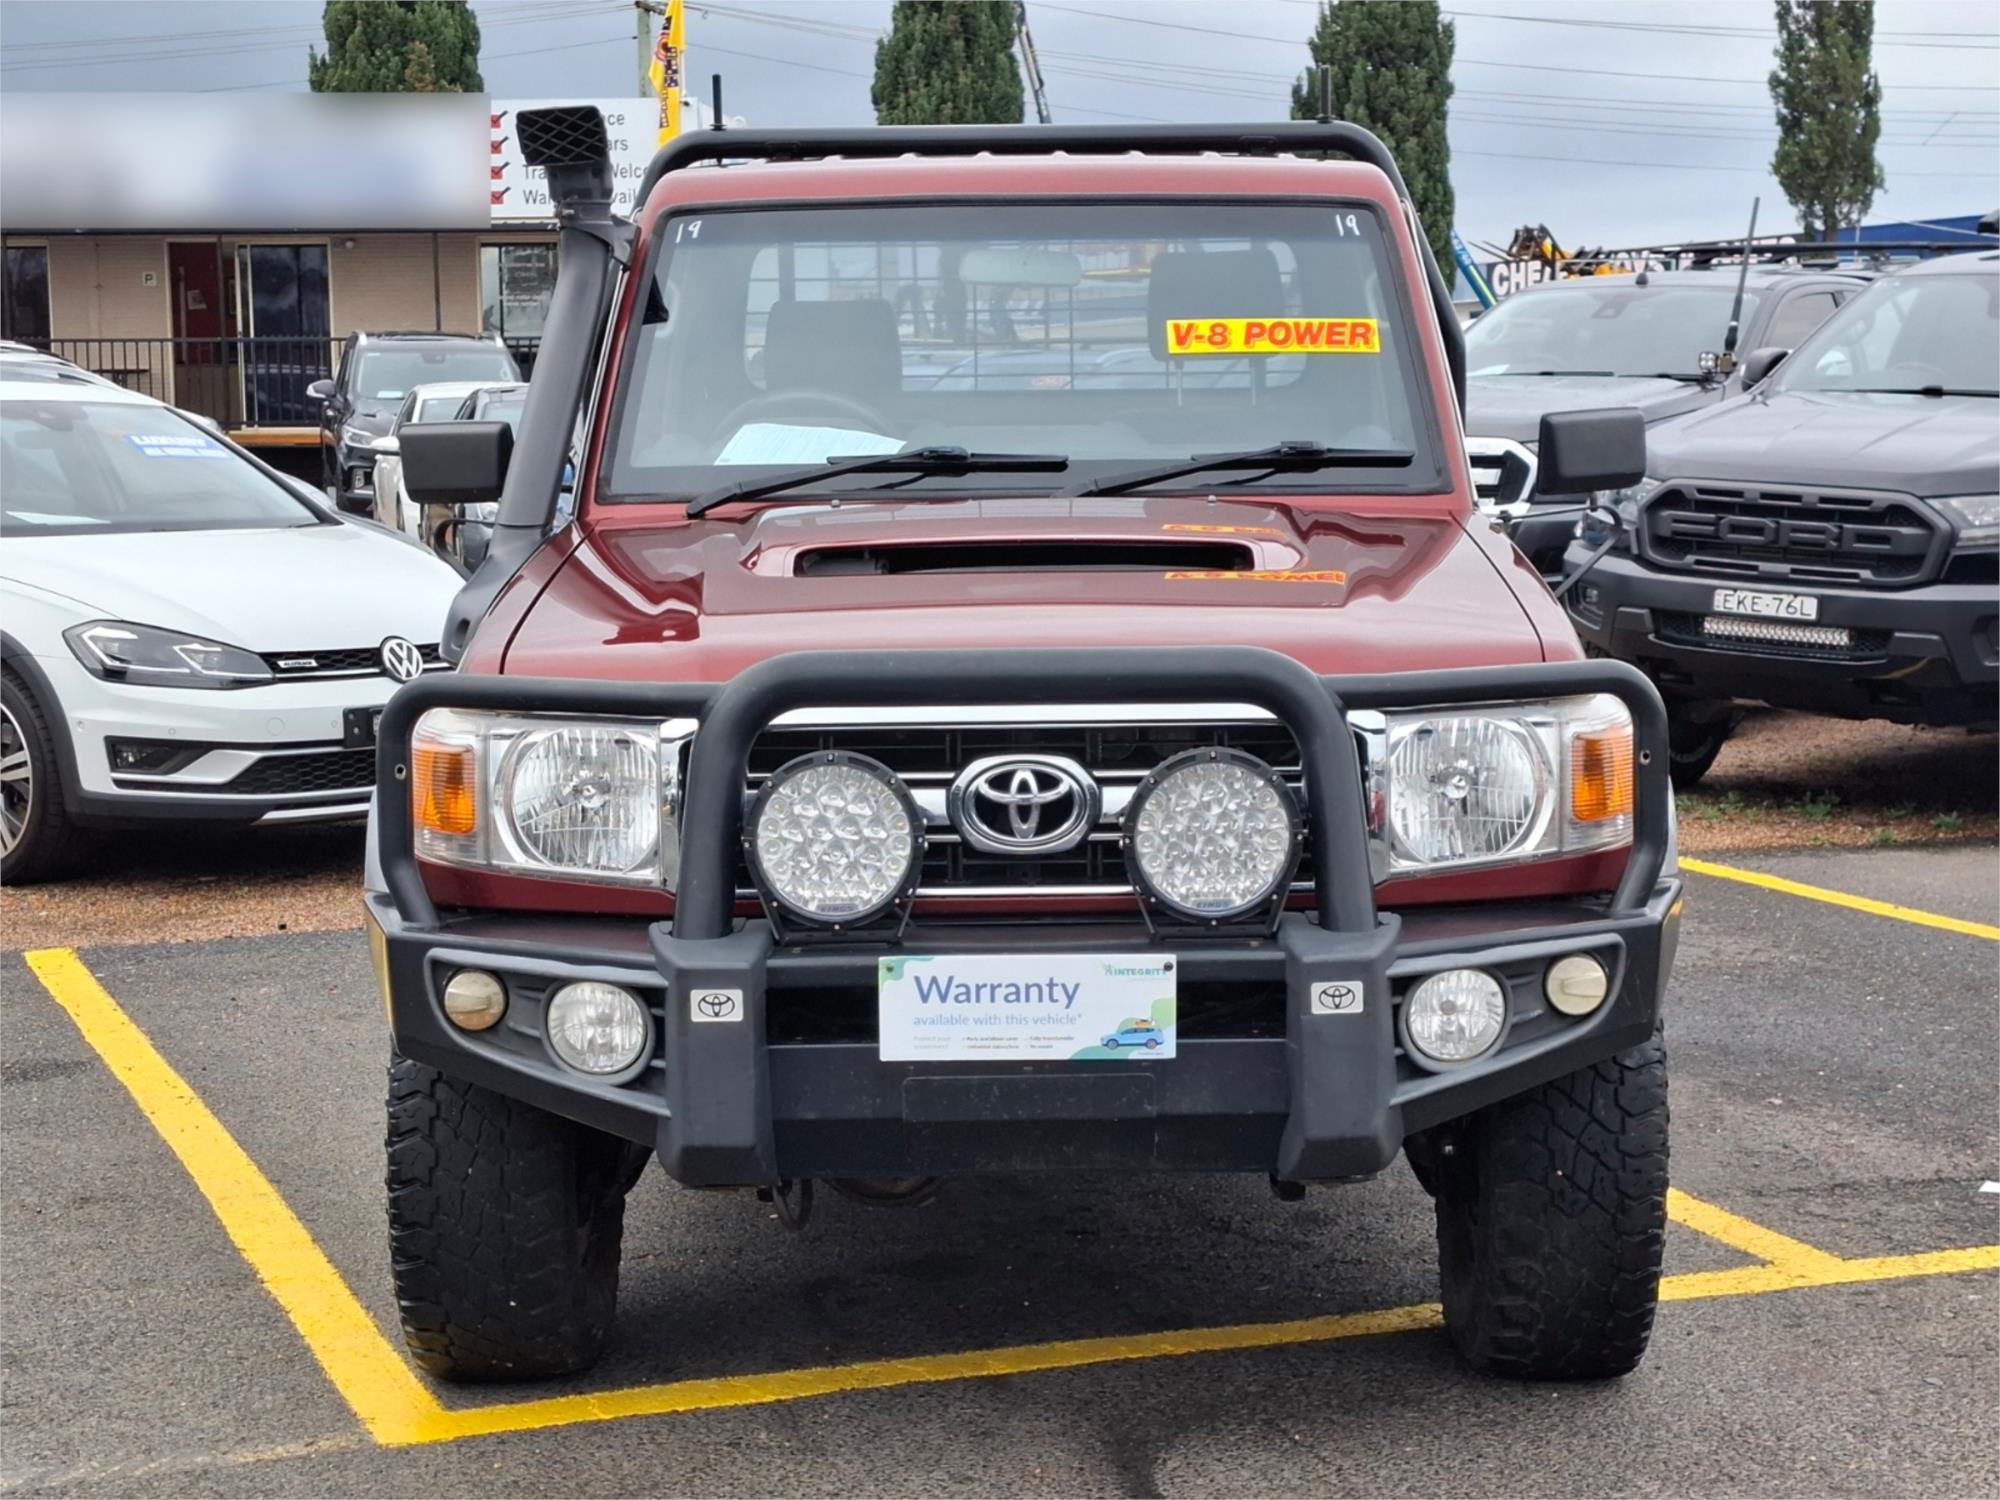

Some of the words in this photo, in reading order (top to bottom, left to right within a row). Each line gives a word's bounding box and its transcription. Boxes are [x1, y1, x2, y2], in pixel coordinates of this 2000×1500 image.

[675, 220, 702, 244] 19
[1335, 214, 1361, 237] 19
[1172, 322, 1232, 349] V-8
[1243, 321, 1376, 348] POWER
[1655, 510, 1922, 556] FORD
[913, 975, 1081, 1010] Warranty
[913, 1013, 970, 1026] available
[972, 1013, 1001, 1026] with
[1005, 1013, 1029, 1025] this
